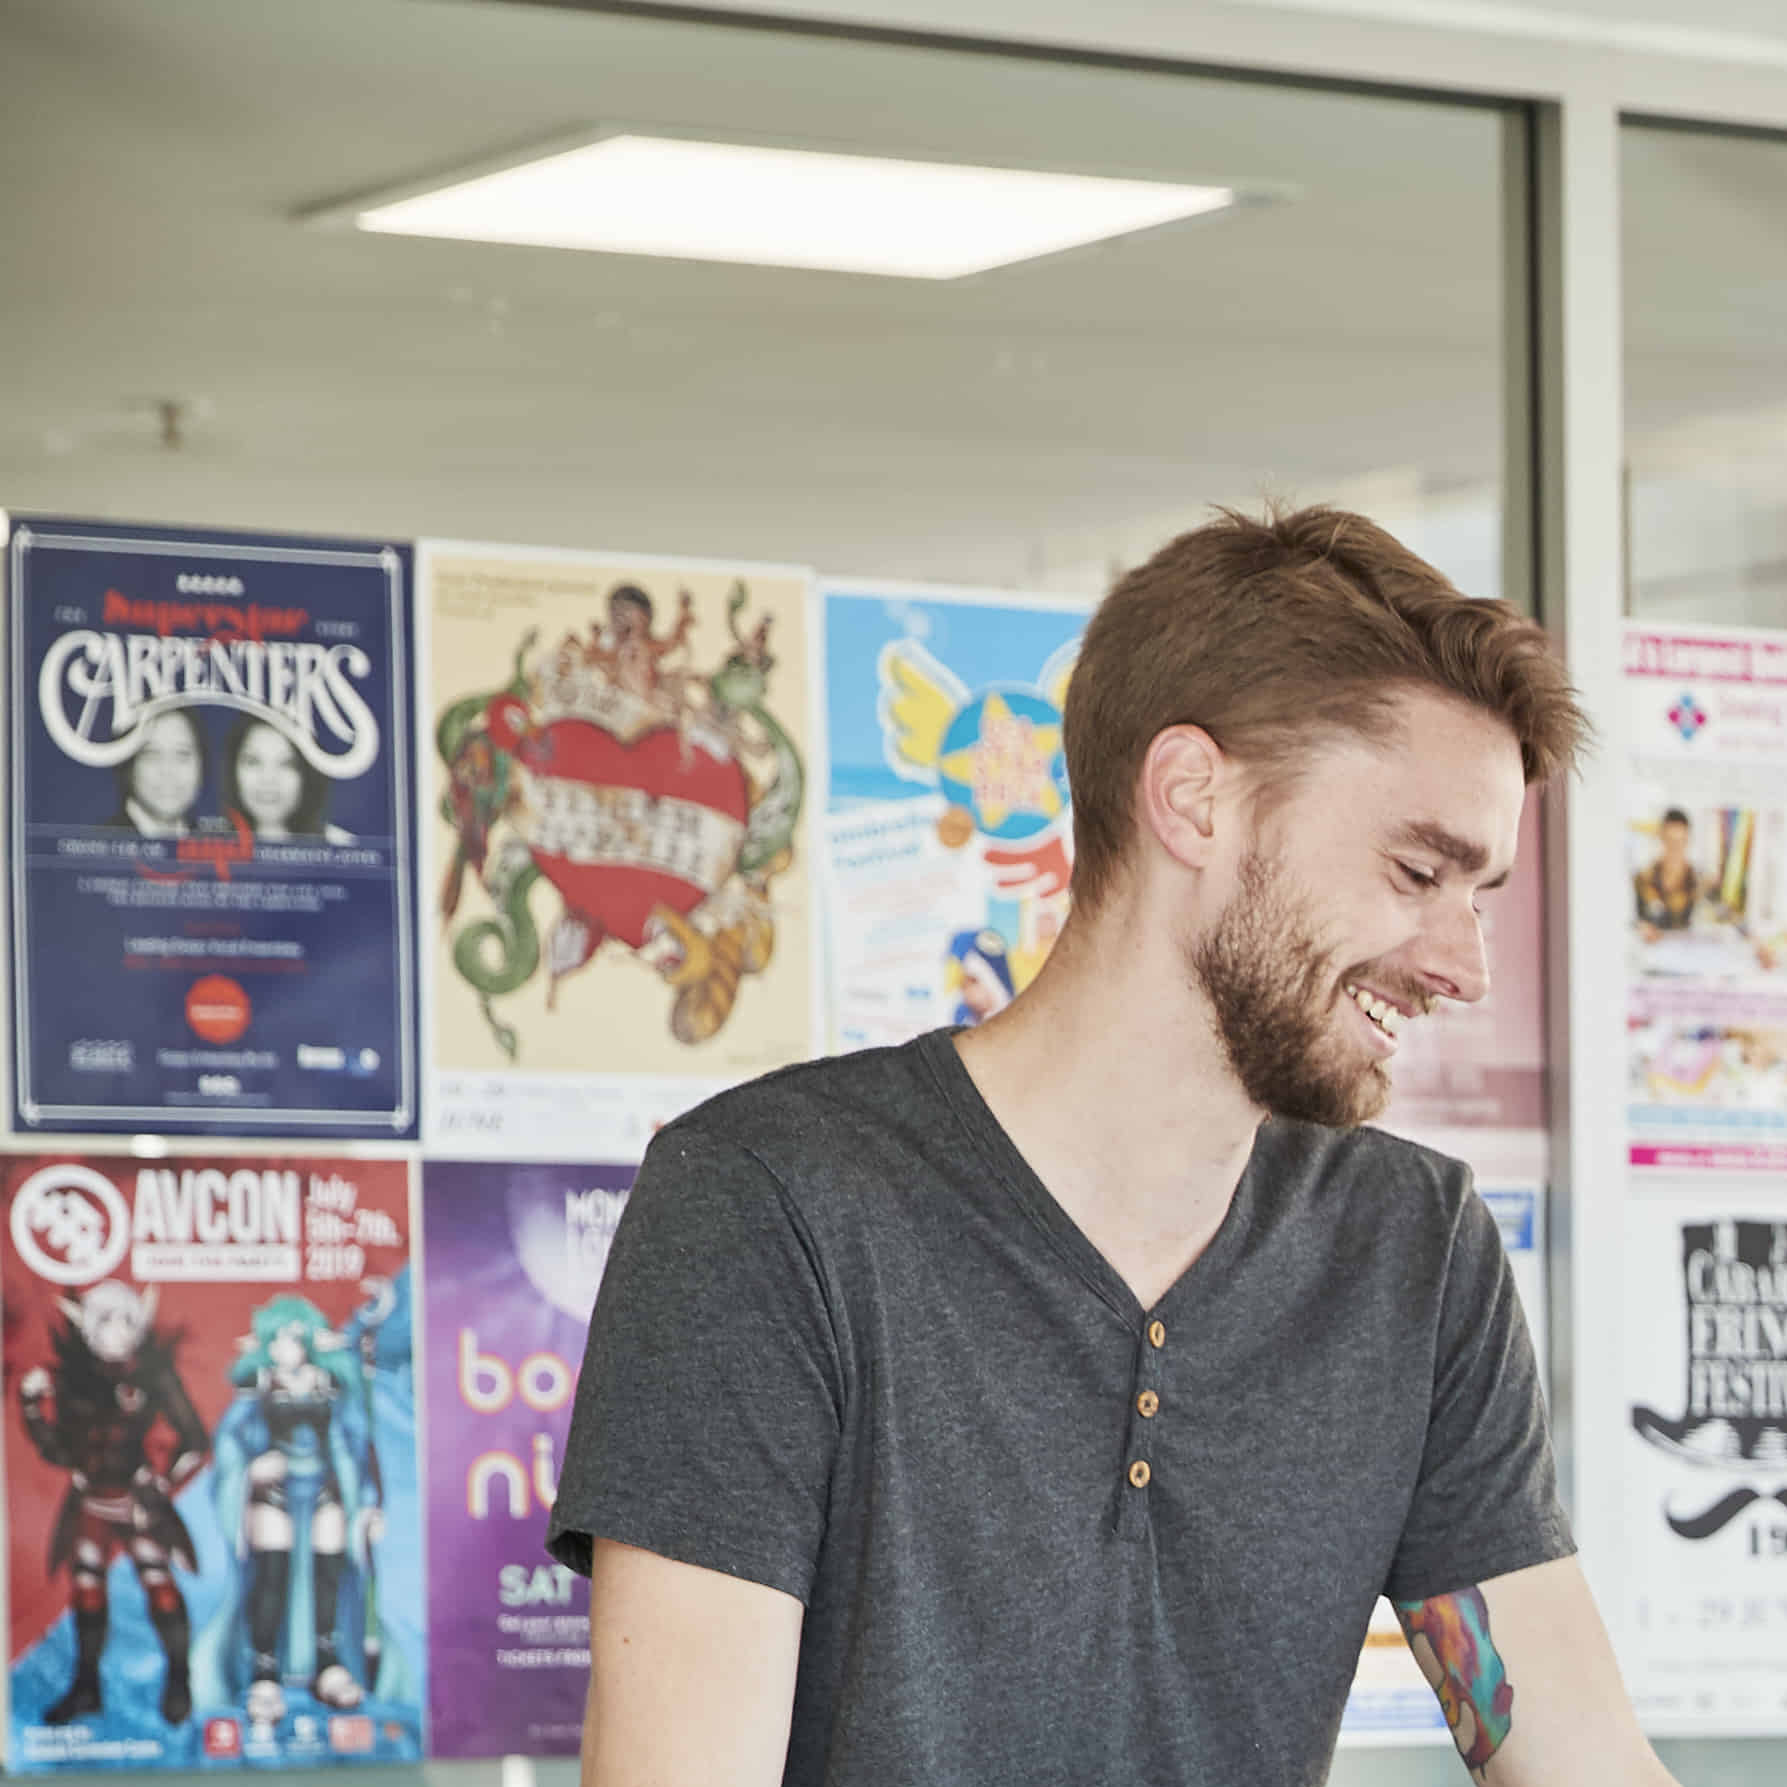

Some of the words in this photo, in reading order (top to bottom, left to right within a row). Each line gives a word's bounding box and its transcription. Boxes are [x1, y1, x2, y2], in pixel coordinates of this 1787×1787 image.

[38, 629, 380, 779] CARPENTERS
[133, 1169, 299, 1244] AVCON
[498, 1564, 576, 1607] SAT
